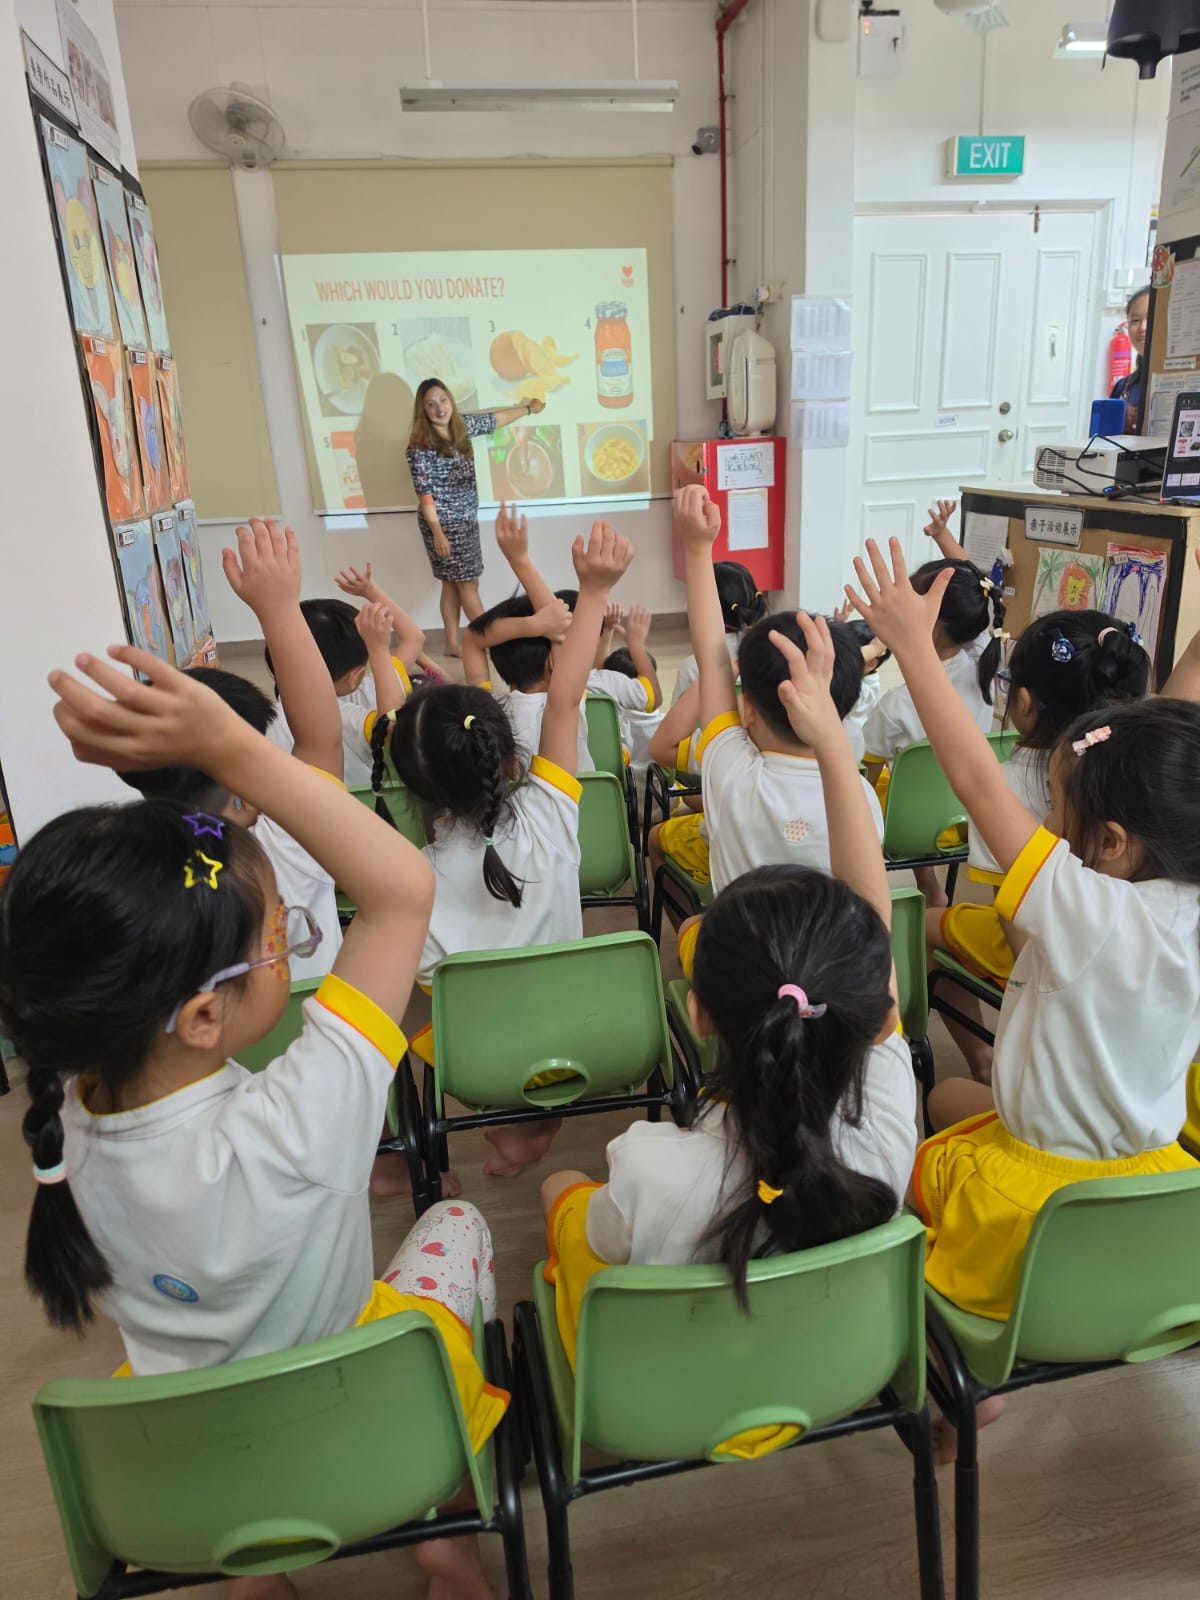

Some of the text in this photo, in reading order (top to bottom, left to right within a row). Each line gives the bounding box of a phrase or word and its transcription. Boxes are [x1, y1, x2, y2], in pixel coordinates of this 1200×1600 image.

[970, 142, 1012, 169] EXIT
[316, 276, 505, 302] WHICH WOULD YOU DONATE?
[391, 322, 399, 336] 2
[488, 319, 495, 333] 3
[584, 317, 591, 330] 4
[323, 436, 330, 449] 5
[1030, 517, 1078, 537] 亲子活动展示
